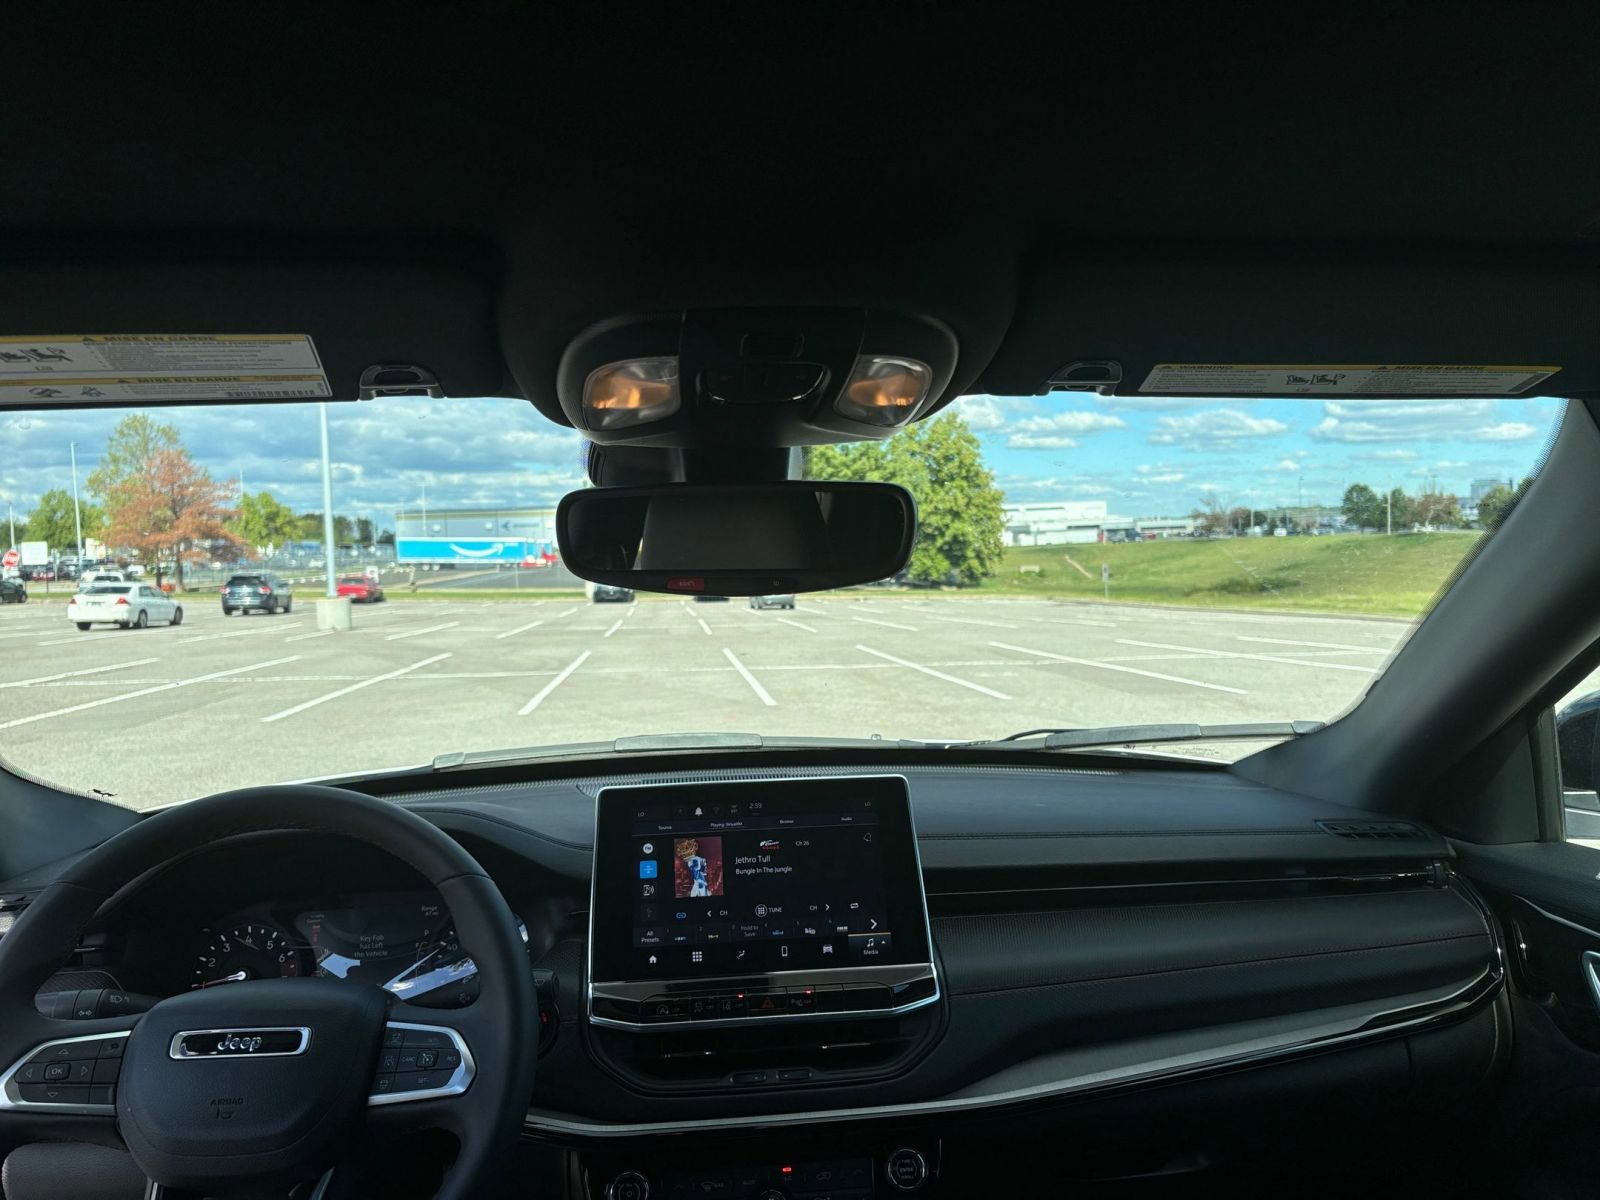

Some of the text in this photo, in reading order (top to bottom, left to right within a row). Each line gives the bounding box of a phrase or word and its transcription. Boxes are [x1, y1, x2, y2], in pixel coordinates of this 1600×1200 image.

[735, 855, 771, 865] Jethro Tull
[736, 868, 756, 876] Bungle
[774, 866, 793, 874] Jungle
[245, 934, 252, 944] 4
[223, 943, 231, 952] 3
[266, 941, 274, 950] 5
[208, 957, 216, 967] 2
[278, 954, 286, 962] 6
[217, 1033, 262, 1052] Jeep
[210, 1097, 243, 1106] AIRBAG
